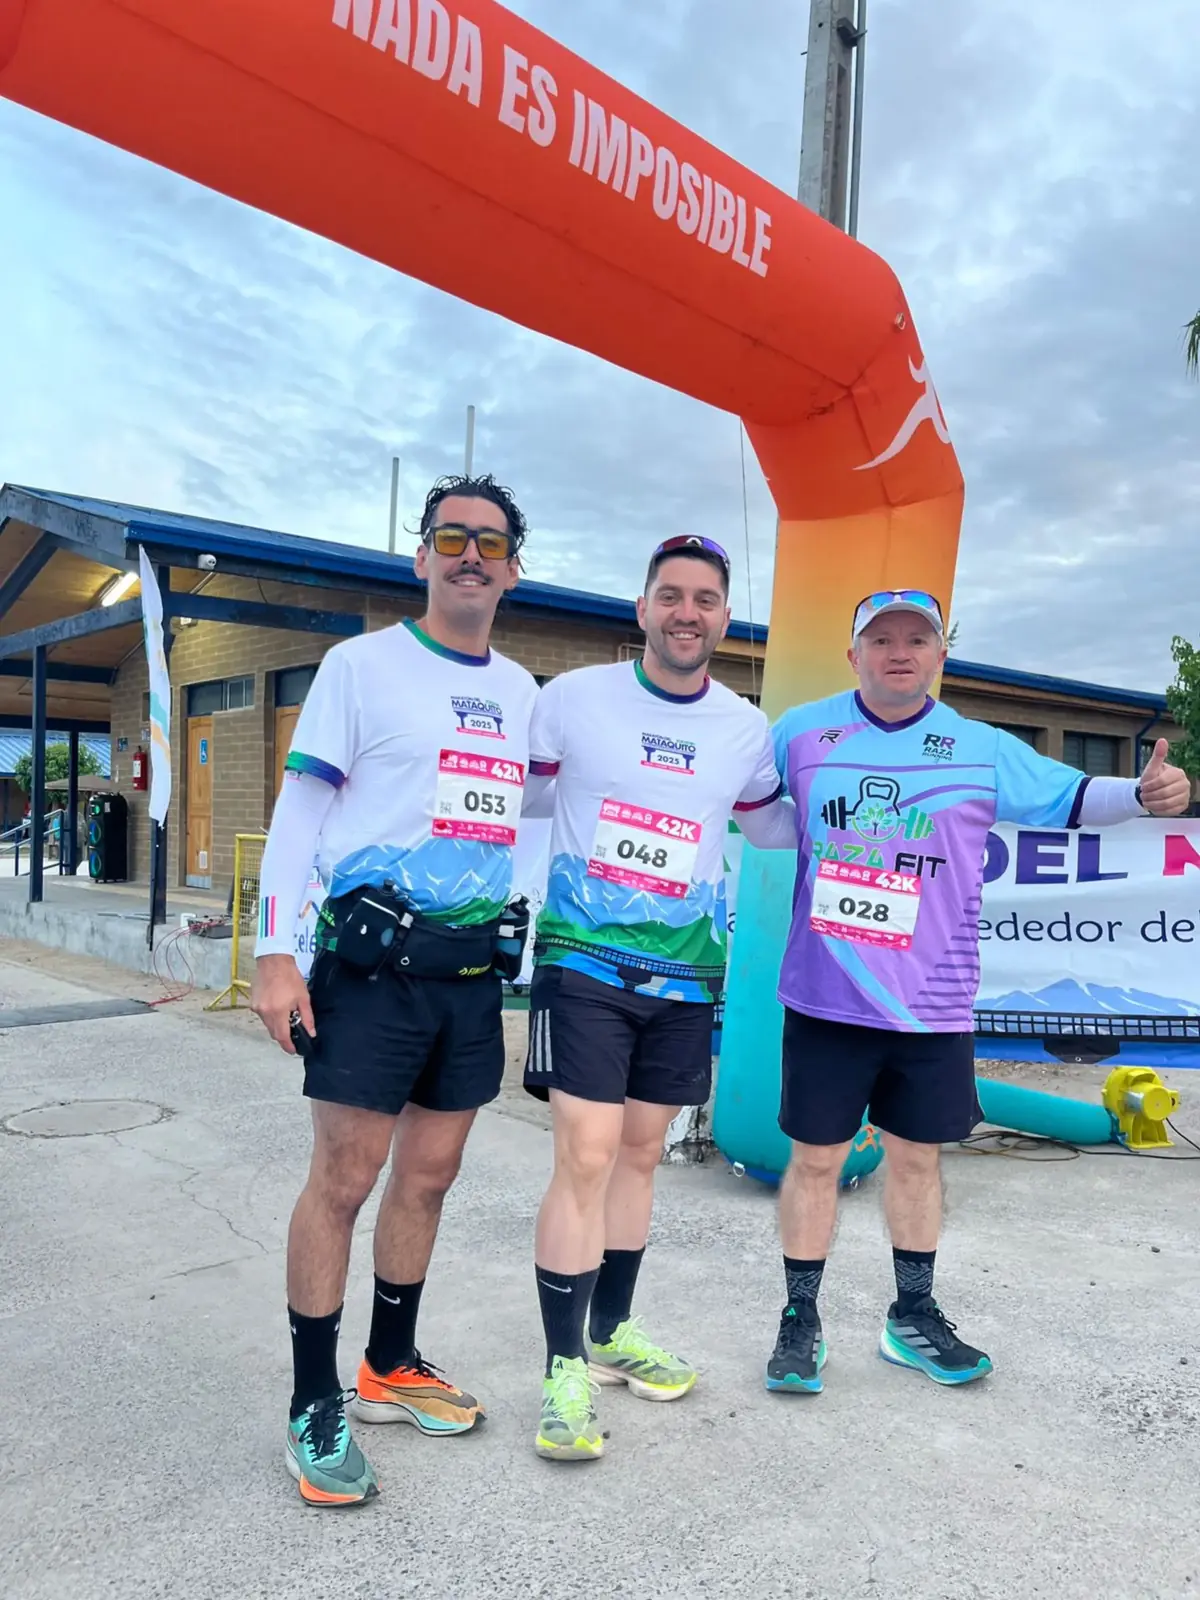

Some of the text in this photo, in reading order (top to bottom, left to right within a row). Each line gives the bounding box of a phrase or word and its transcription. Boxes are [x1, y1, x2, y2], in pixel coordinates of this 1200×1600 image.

[498, 44, 558, 148] ES
[568, 89, 772, 278] IMPOSIBLE
[451, 699, 503, 715] MATAQUITO
[470, 719, 492, 730] 2025
[641, 735, 696, 753] MATAQUITO
[922, 733, 956, 750] RR
[923, 746, 953, 757] RAZA
[657, 754, 680, 765] 2025
[490, 761, 522, 783] 42K
[464, 790, 506, 816] 053
[656, 817, 697, 840] 42K
[617, 839, 668, 868] 048
[812, 841, 947, 878] RAZA FIT
[875, 872, 917, 893] 42K
[838, 897, 889, 922] 028
[1140, 909, 1200, 942] de
